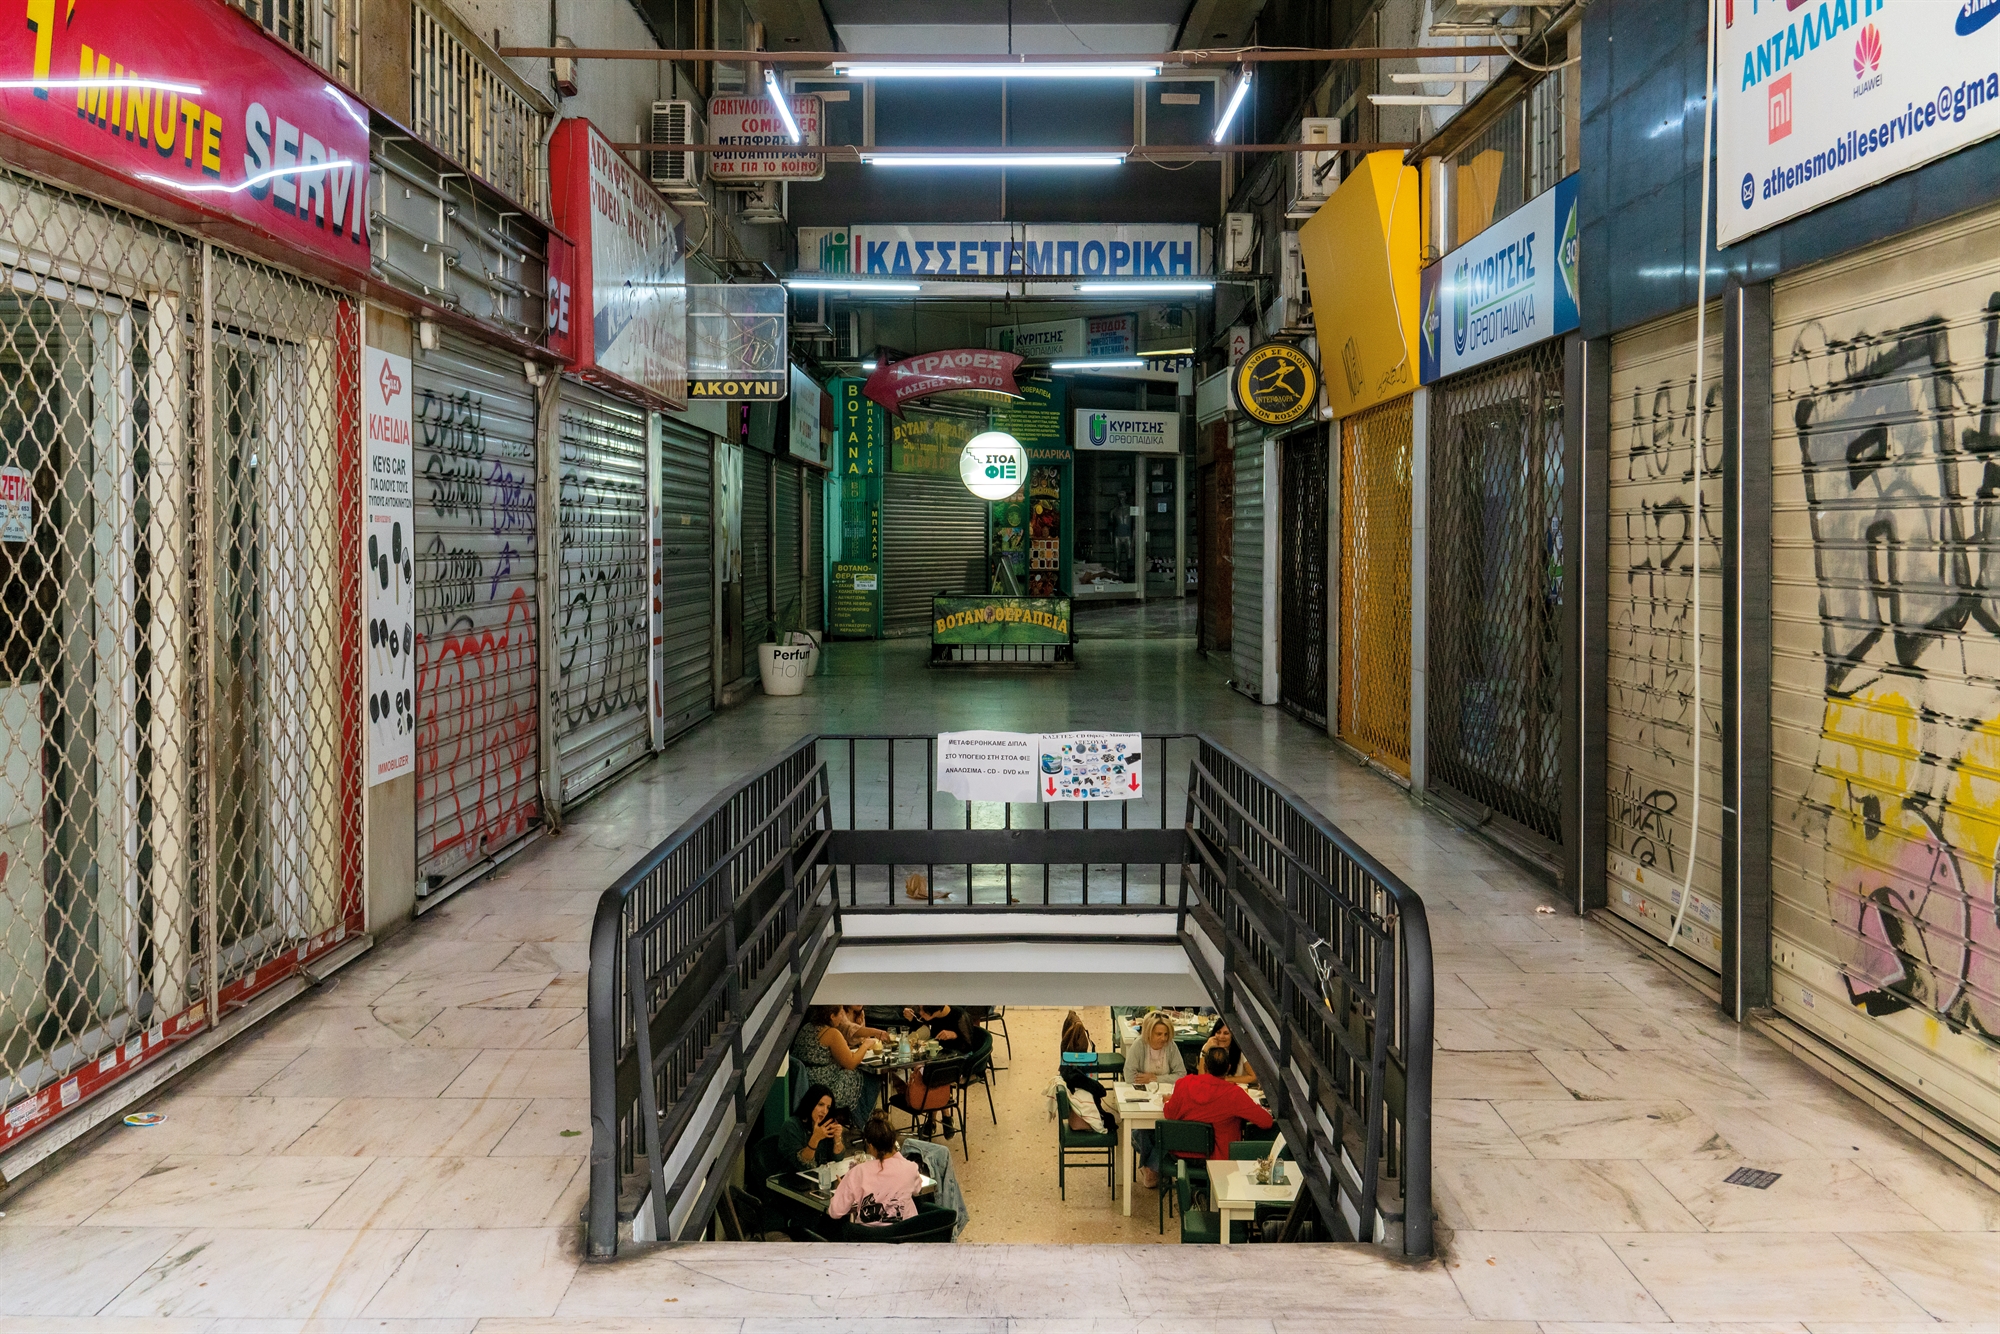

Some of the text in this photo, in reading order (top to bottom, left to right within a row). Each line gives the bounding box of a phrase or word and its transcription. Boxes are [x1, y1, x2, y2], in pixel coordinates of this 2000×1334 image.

[1964, 0, 1997, 18] SAM
[1853, 74, 1883, 99] HUAWEI
[77, 44, 223, 179] MINUTE
[741, 118, 817, 133] COMPER
[1763, 72, 1999, 200] athensmobileservice@gma
[244, 102, 371, 243] SERVI
[713, 162, 735, 173] FAX
[741, 162, 758, 172] ΓΙΑ
[763, 162, 776, 172] ΤΟ
[867, 239, 1192, 275] ΚΑΣΣΕΤΕΜΠΟΡΙΚΗ
[1470, 231, 1536, 307] ΚΥΡΙΤΣΗΣ
[548, 276, 571, 336] CE
[1090, 319, 1126, 334] ΕΞΟΔΟΣ
[1470, 293, 1536, 350] ΟΡΘΟΠΑΙΔΙΚΑ
[1016, 330, 1064, 346] ΚΥΡΙΤΣΗΣ
[896, 352, 1003, 380] ΑΓΡΑΦΕΣ
[1246, 352, 1267, 371] ΑΝΘΗ
[1286, 351, 1307, 369] ΟΛΟΝ
[896, 377, 946, 398] ΚΑΣΕΤΕΣ
[979, 375, 1003, 386] DVD
[1254, 404, 1304, 420] ΤΟΝ ΚΟΣΜΟ
[369, 413, 411, 446] ΚΛΕΙΔΙΑ
[848, 384, 859, 474] ΒΟΤΑΝΑ
[866, 400, 874, 474] ΜΠΑΧΑΡΙΚΑ
[1109, 420, 1165, 434] ΚΥΡΙΤΣΗΣ
[1109, 434, 1165, 445] ΟΡΘΟΠΑΙΔΙΚΑ
[985, 454, 1016, 464] ΣΤΟΑ
[1025, 447, 1071, 460] ΠΑΧΑΡΙΚΑ
[372, 455, 406, 475] KEYS CAR
[985, 465, 1017, 479] ΦΙΞ
[370, 478, 409, 494] ΓΙΑ ΟΛΟΥΣ ΤΟΥΣ
[377, 754, 409, 775] IMMOBILIZER
